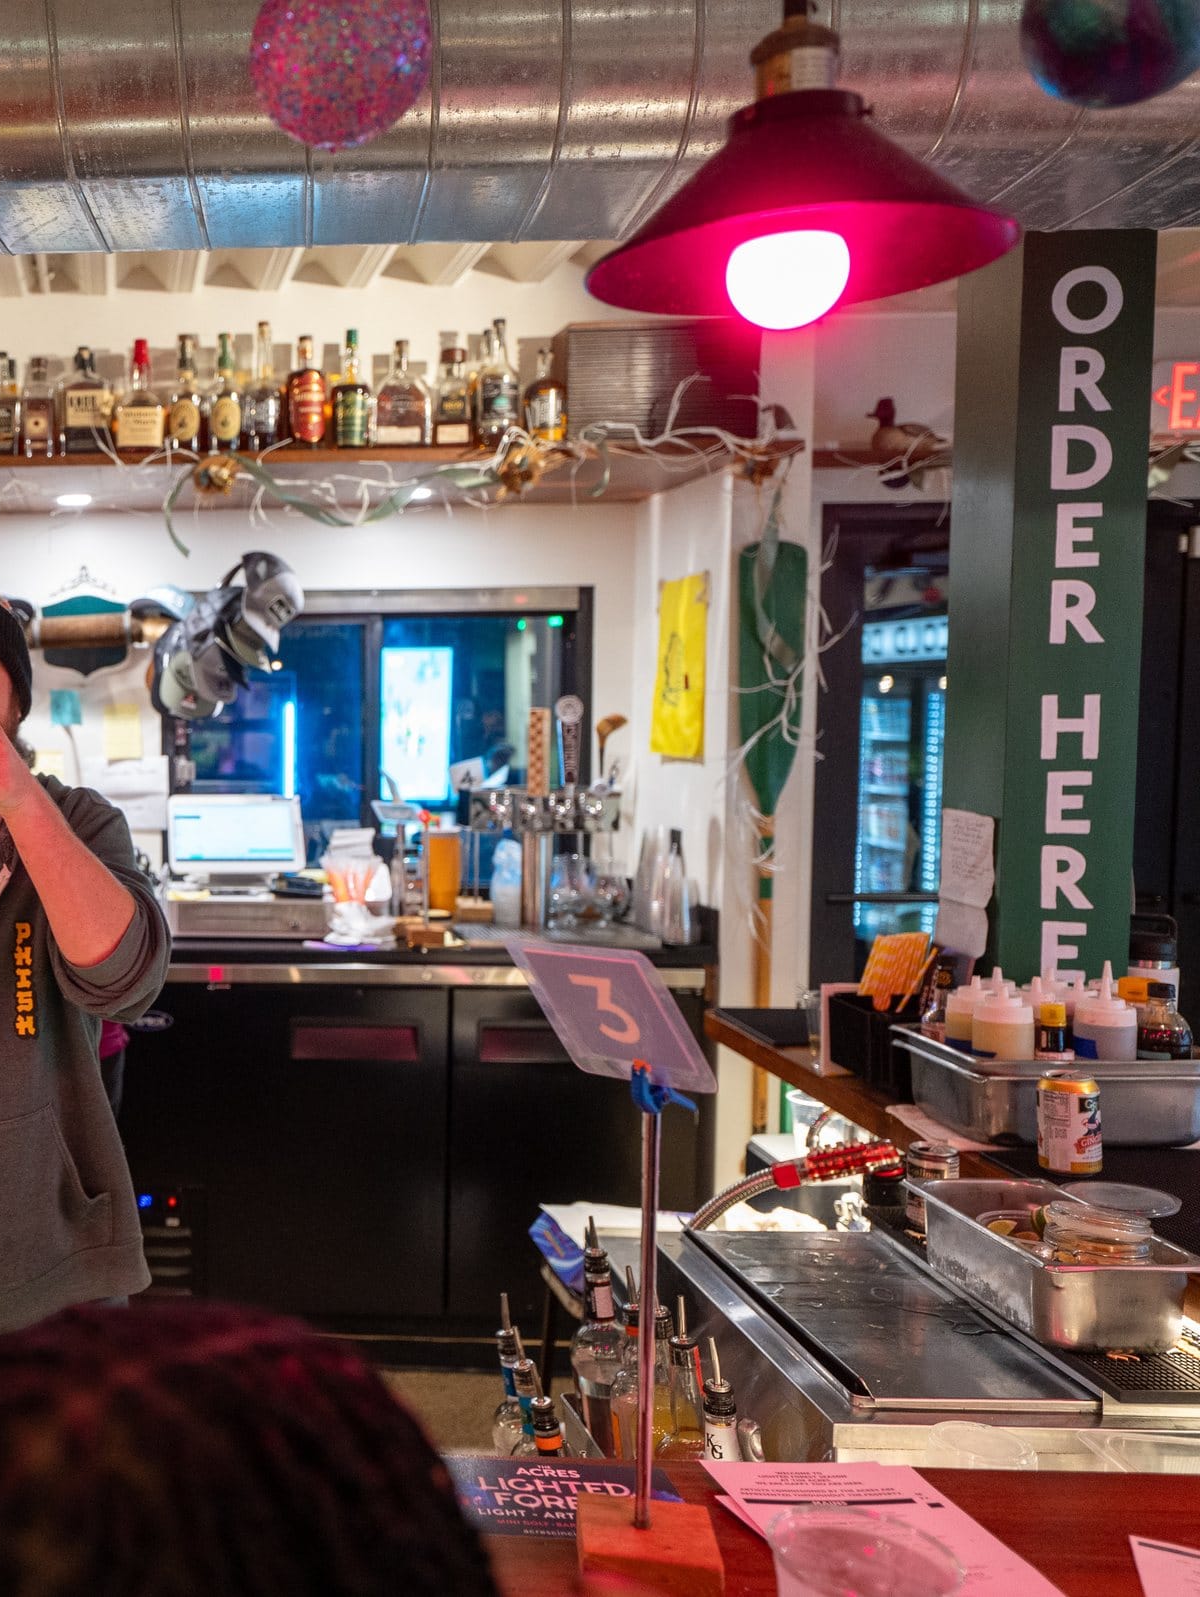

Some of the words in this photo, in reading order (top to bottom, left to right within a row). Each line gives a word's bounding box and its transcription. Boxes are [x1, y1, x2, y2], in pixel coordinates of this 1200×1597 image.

[1168, 362, 1200, 431] E
[1050, 265, 1124, 645] ORDER
[1040, 693, 1101, 984] HERE
[14, 922, 36, 1036] PHISH
[568, 974, 641, 1045] 3
[477, 1476, 631, 1498] LIGHTED
[494, 1492, 578, 1511] FORE
[516, 1467, 581, 1479] ACRES
[478, 1508, 527, 1517] LIGHT
